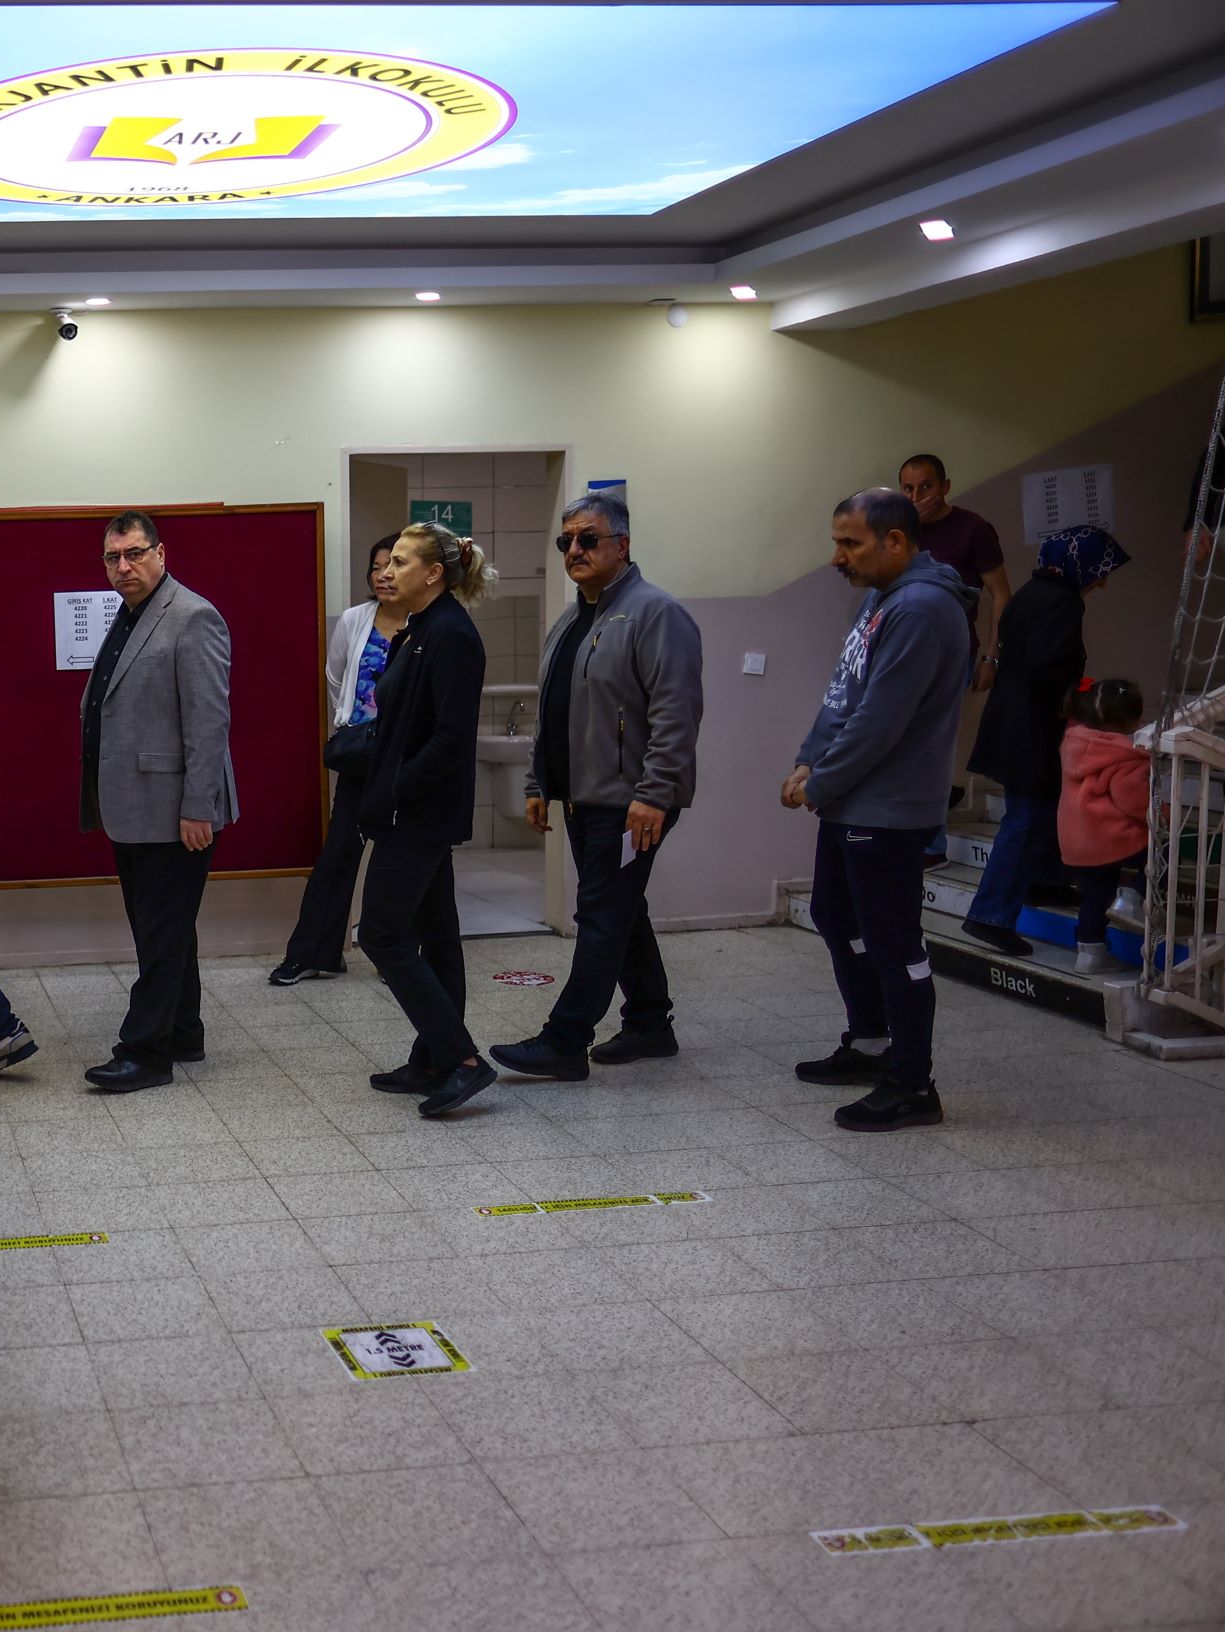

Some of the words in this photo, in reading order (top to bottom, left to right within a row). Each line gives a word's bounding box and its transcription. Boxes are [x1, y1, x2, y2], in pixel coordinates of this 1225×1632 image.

[284, 55, 487, 115] İLKOKULU
[162, 131, 242, 145] ARJ
[54, 192, 247, 204] ANKARA
[431, 504, 454, 522] 14
[990, 967, 1037, 998] Black
[366, 1347, 384, 1355] 1.5
[386, 1343, 424, 1353] METRE
[21, 1603, 111, 1620] MESAFENİZİ
[114, 1595, 209, 1613] KORUYUNUZ
